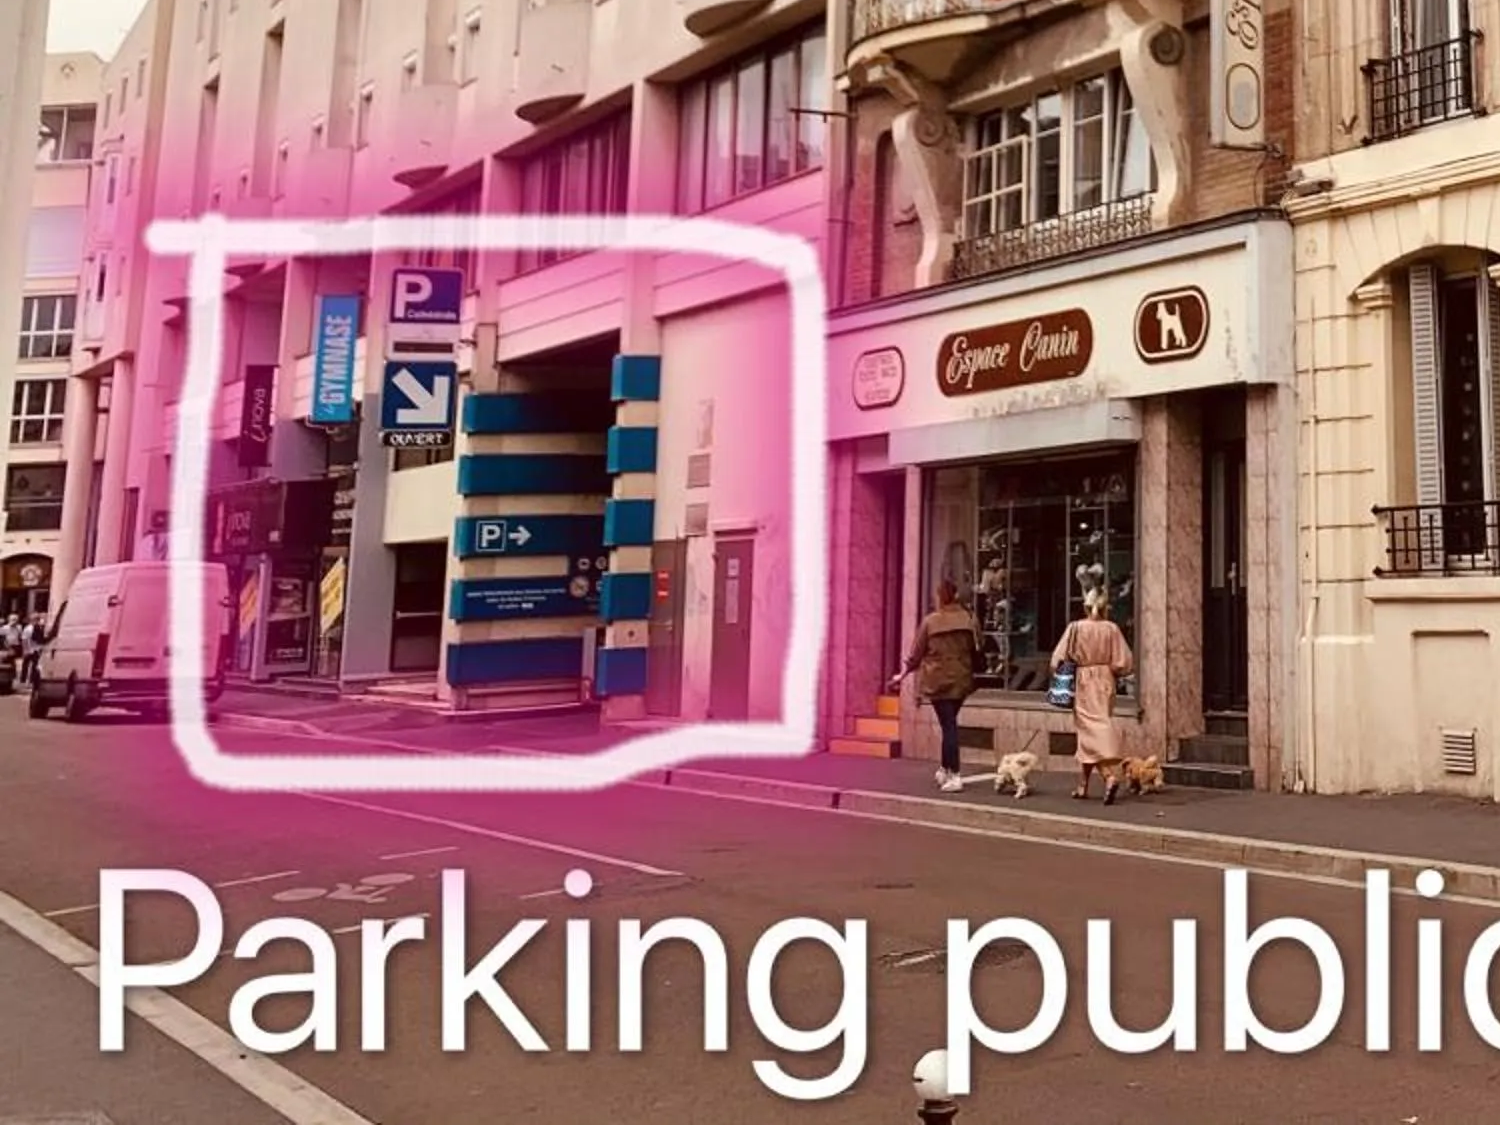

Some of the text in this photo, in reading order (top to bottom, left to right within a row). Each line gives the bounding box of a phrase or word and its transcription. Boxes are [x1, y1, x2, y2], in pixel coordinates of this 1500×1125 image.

[393, 274, 433, 318] P
[319, 315, 353, 405] GYMNASE
[945, 335, 1011, 389] Espace
[1018, 321, 1080, 373] Canin
[481, 525, 502, 548] P
